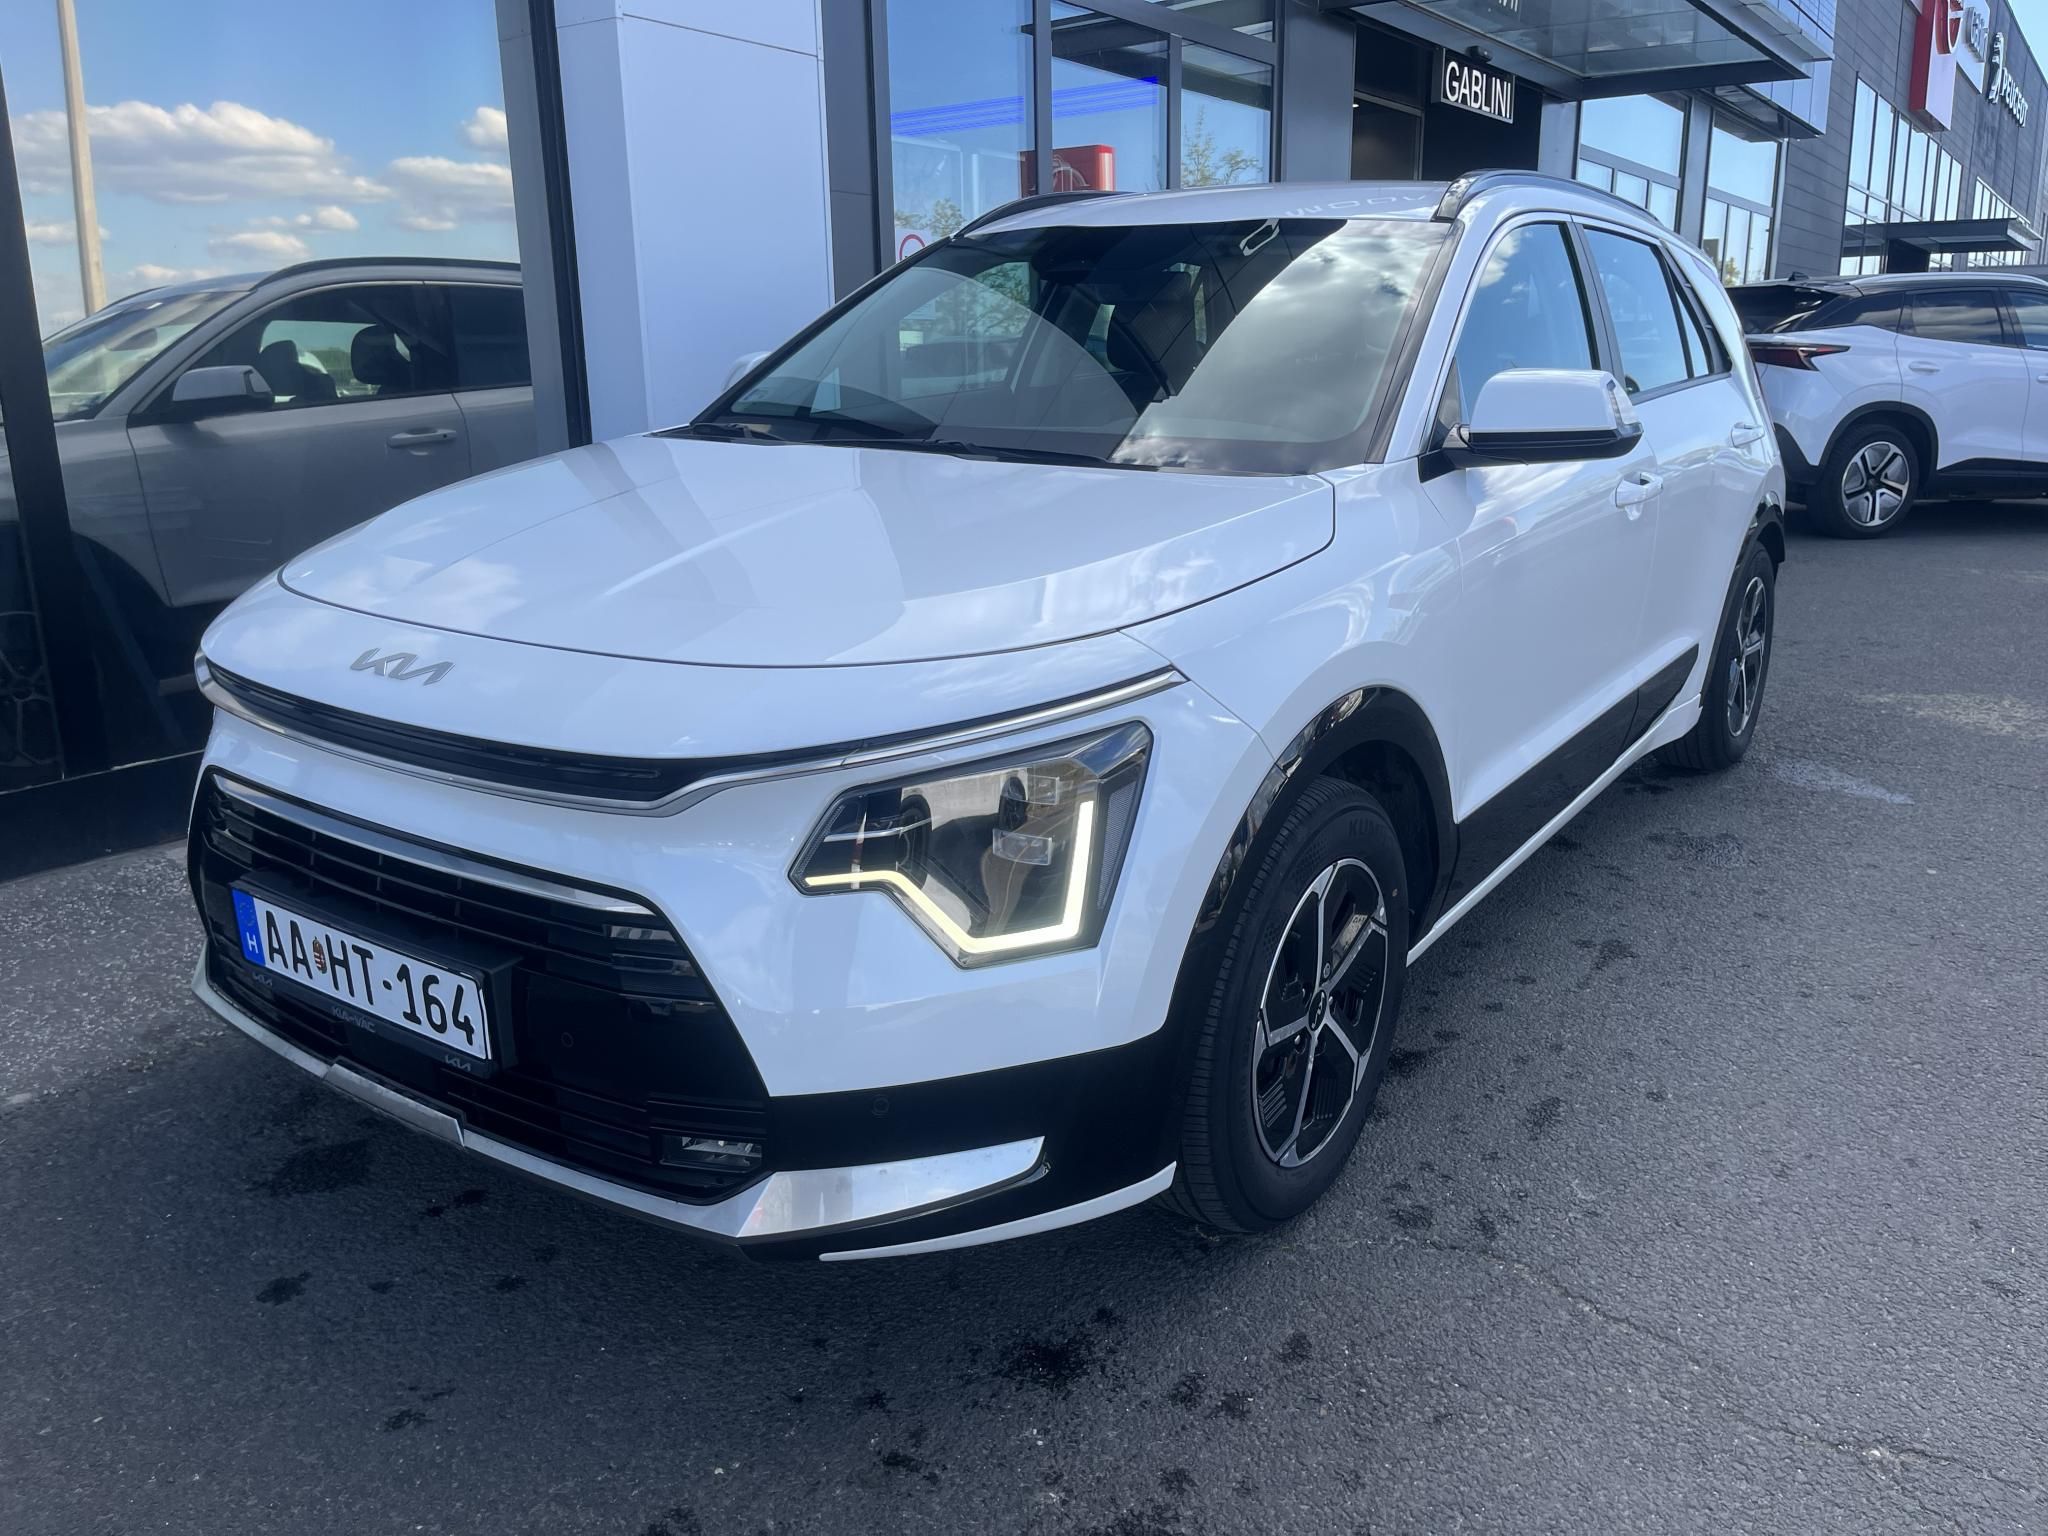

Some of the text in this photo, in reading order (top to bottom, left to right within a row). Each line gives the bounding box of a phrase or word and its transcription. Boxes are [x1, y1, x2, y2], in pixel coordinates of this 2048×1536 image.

[1446, 61, 1511, 118] GABLINI
[2000, 66, 2028, 128] PEUGEOT
[246, 931, 259, 955] H
